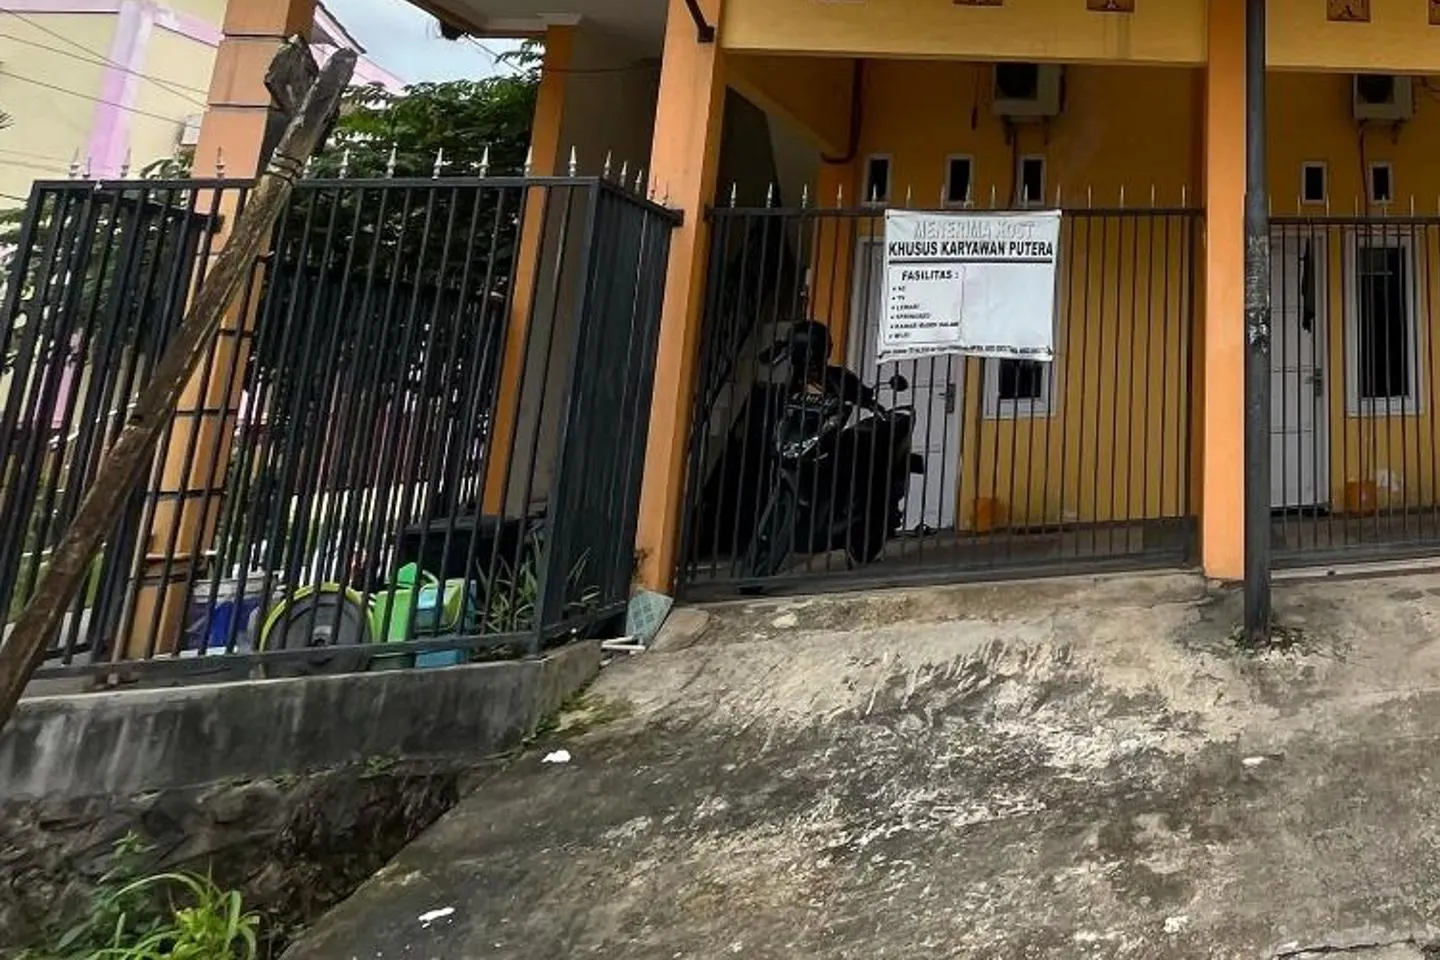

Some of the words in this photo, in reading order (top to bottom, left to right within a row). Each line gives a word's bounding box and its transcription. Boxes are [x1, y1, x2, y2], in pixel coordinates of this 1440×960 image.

[888, 241, 938, 257] KHUSUS
[940, 241, 1005, 256] KARYAWAN
[1009, 241, 1053, 256] PUTERA
[901, 270, 953, 281] FASILITAS
